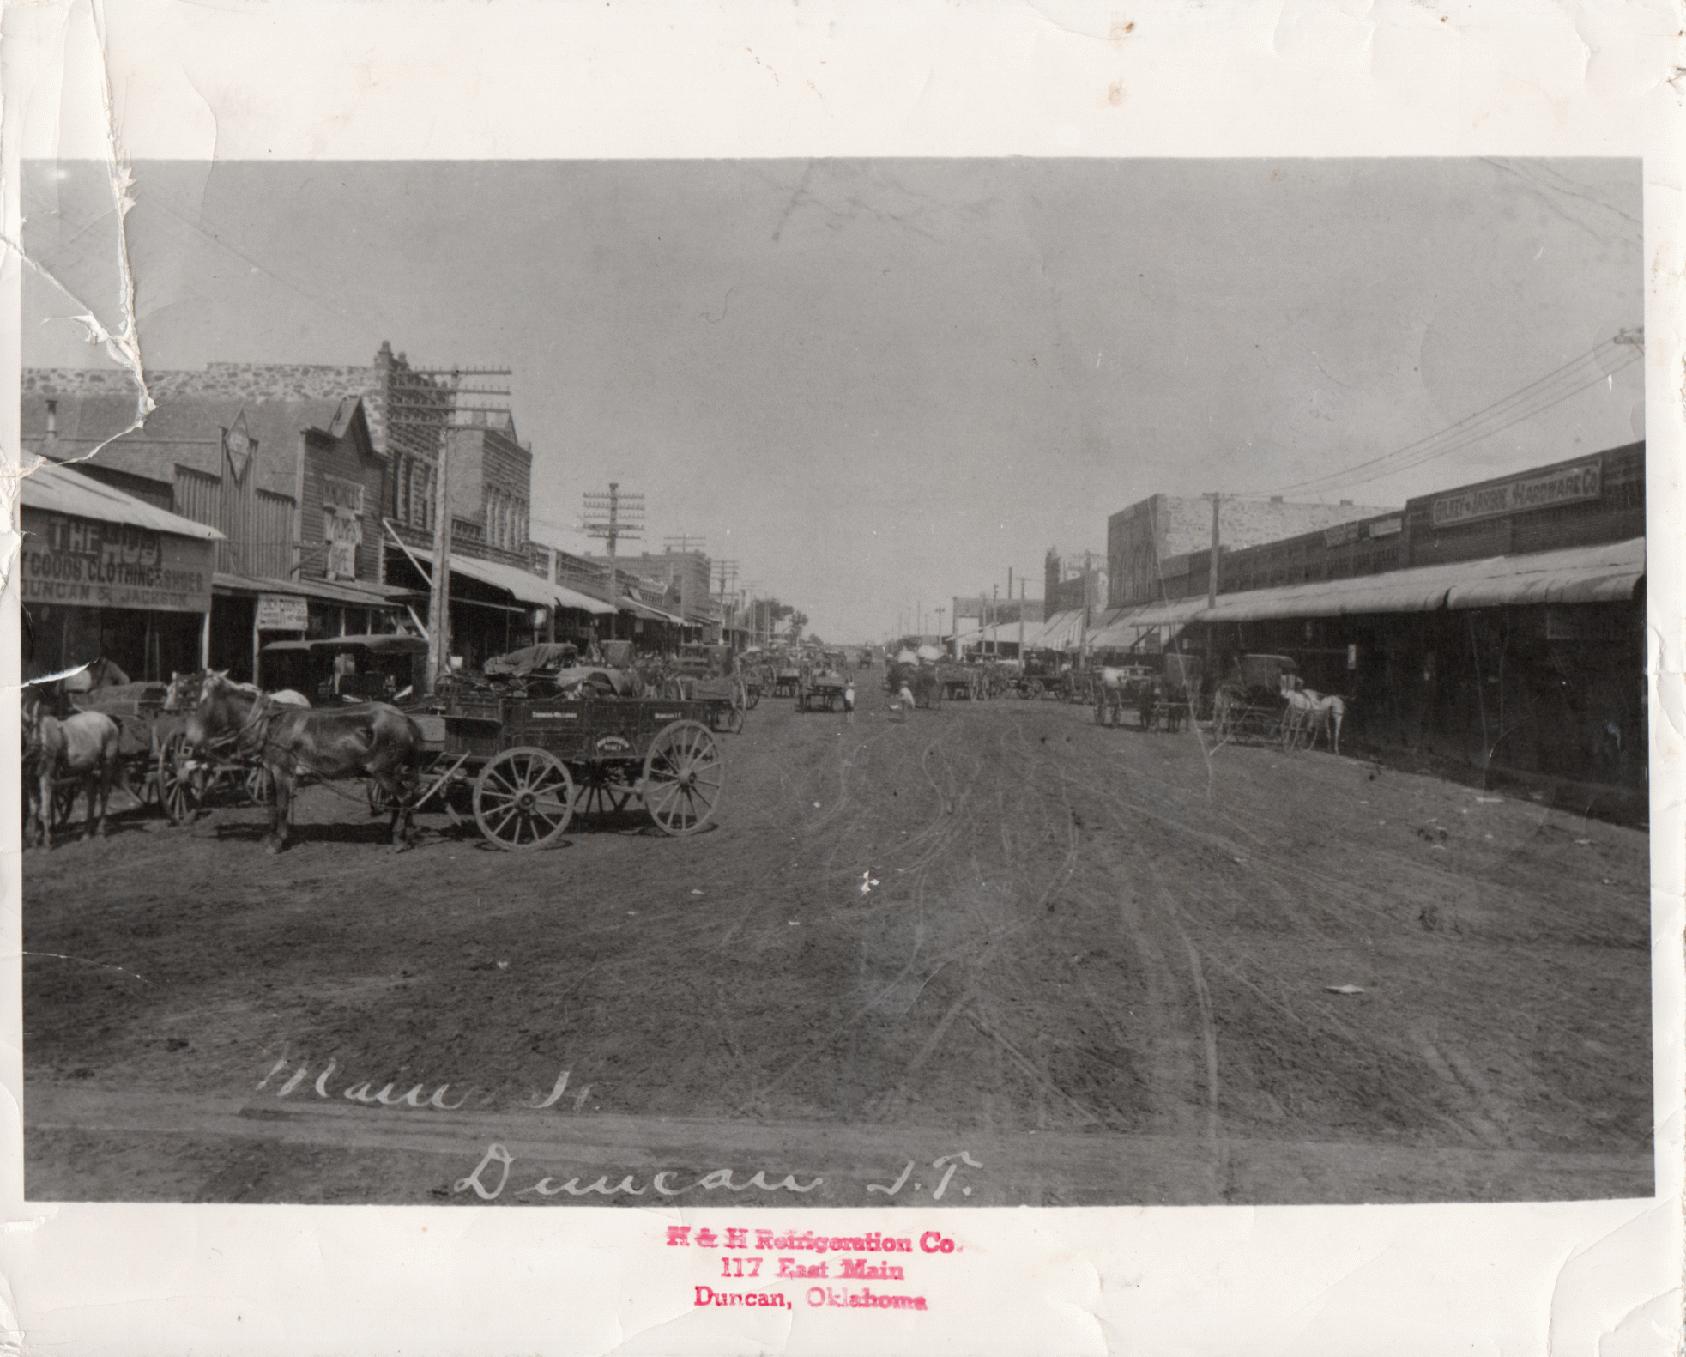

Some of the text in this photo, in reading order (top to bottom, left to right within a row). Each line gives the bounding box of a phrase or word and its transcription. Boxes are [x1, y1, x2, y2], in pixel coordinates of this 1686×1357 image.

[49, 517, 99, 556] THE
[254, 1057, 480, 1110] Main
[454, 1143, 824, 1200] Duncan
[695, 1227, 719, 1248] &
[754, 1229, 914, 1254] Refrigeration
[919, 1231, 964, 1254] Co.
[721, 1257, 905, 1281] 117 East Main
[693, 1286, 929, 1312] Duncan, Oklahoma
